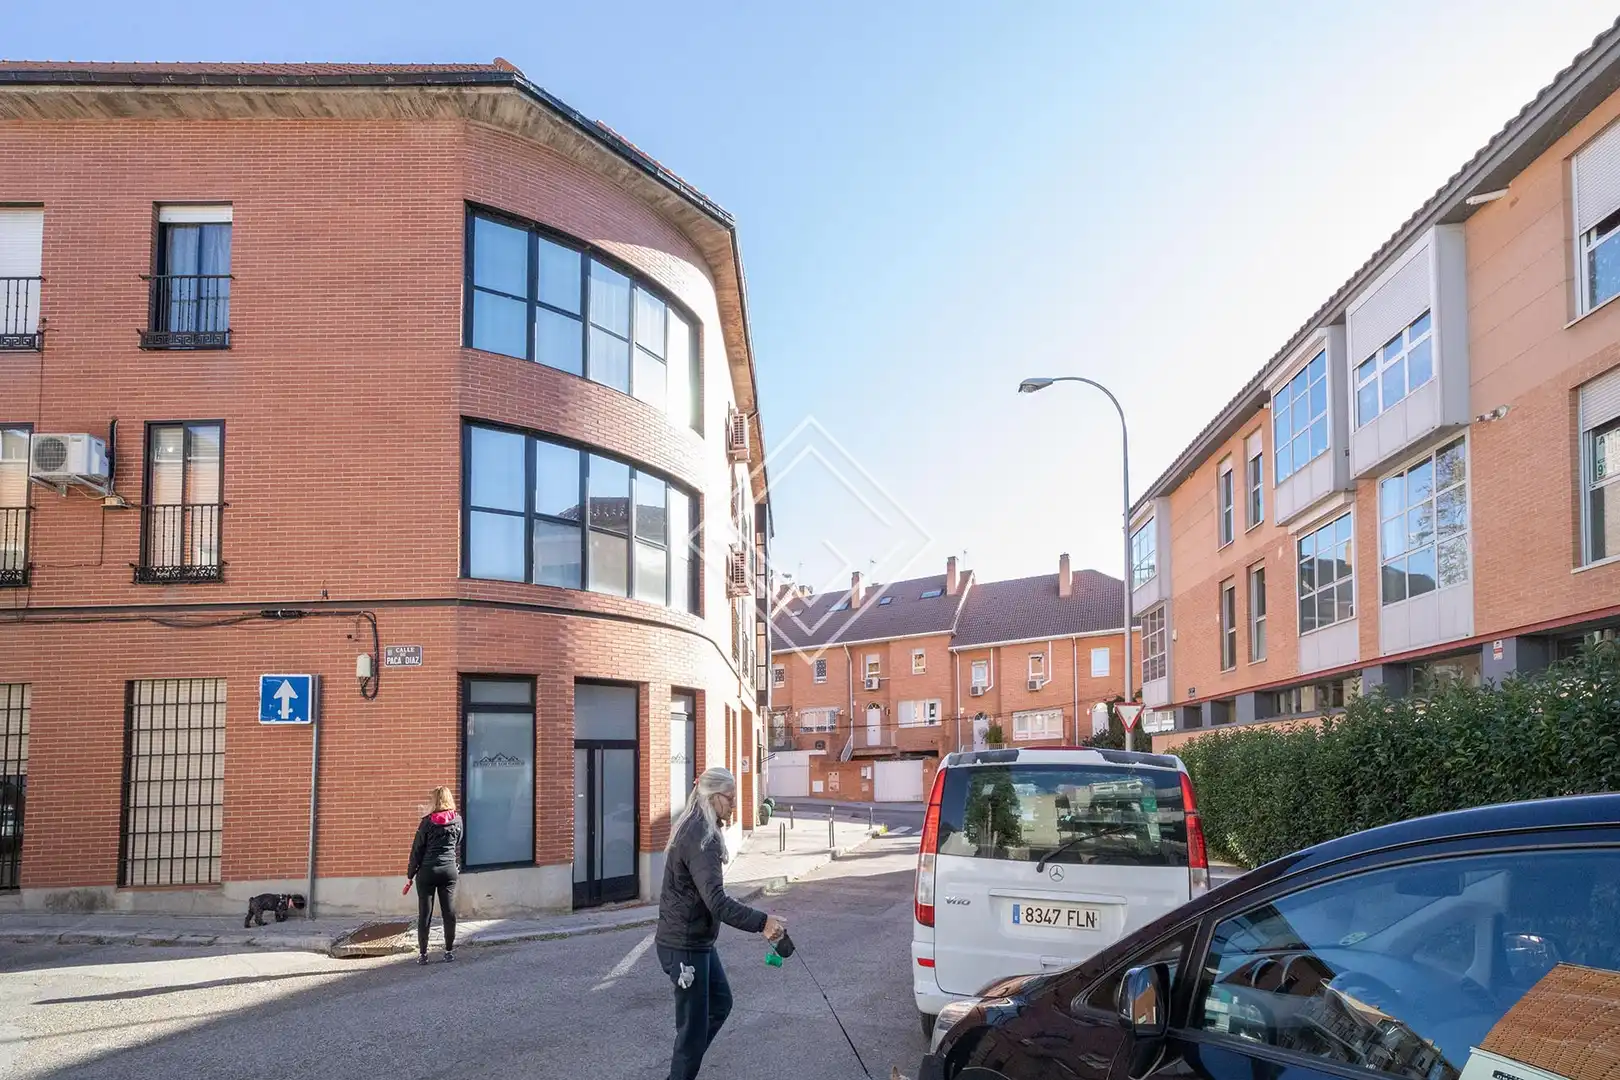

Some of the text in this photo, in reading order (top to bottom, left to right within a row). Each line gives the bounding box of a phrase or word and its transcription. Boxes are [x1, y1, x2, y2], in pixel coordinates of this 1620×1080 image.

[386, 656, 420, 665] PACA DIAZ
[1025, 907, 1095, 928] 8347 FLN
